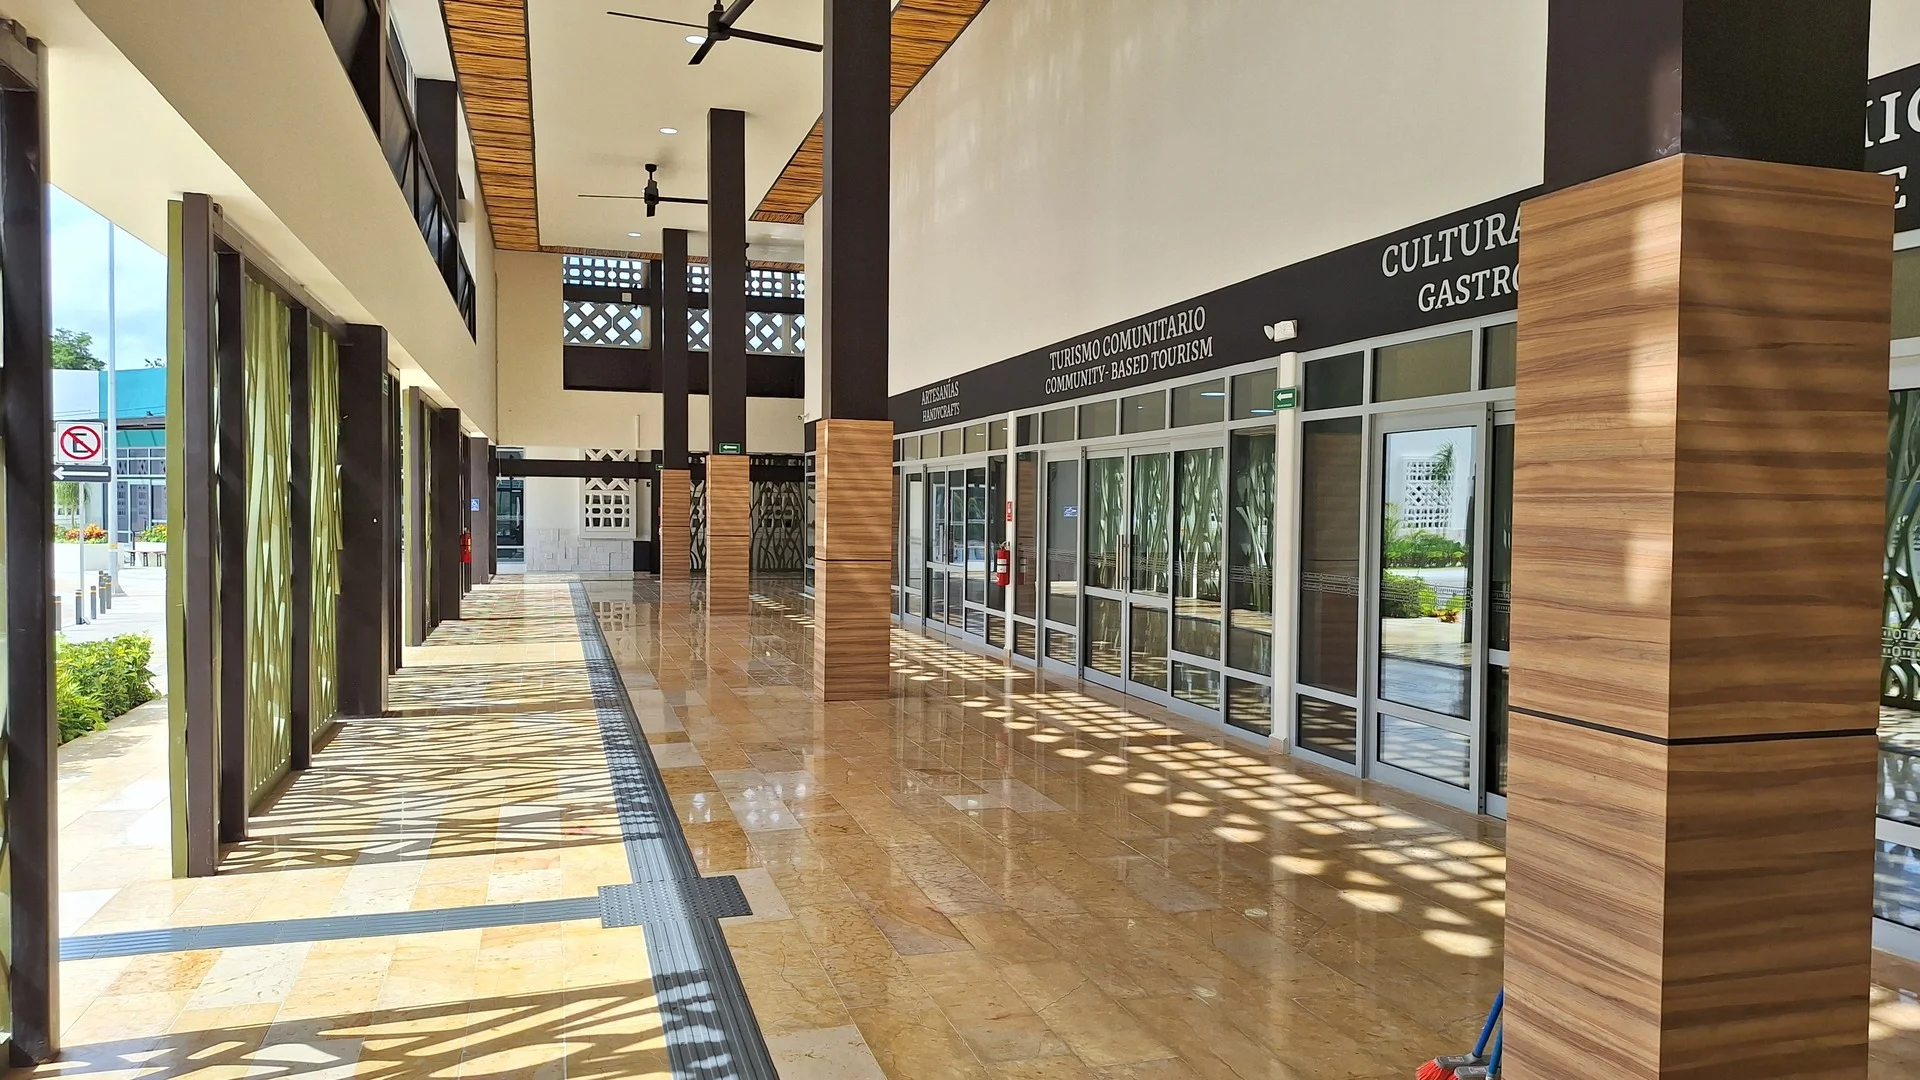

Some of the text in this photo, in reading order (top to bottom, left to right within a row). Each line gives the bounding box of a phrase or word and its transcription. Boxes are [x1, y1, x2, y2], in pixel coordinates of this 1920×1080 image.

[1418, 263, 1520, 312] GASTR
[1050, 306, 1206, 371] TURISMO COMUNITARIO
[1111, 353, 1149, 381] BASED
[1151, 336, 1213, 371] TOURISM
[921, 379, 959, 405] ARTESANÍAS
[922, 402, 960, 422] HANDYCRAFTS
